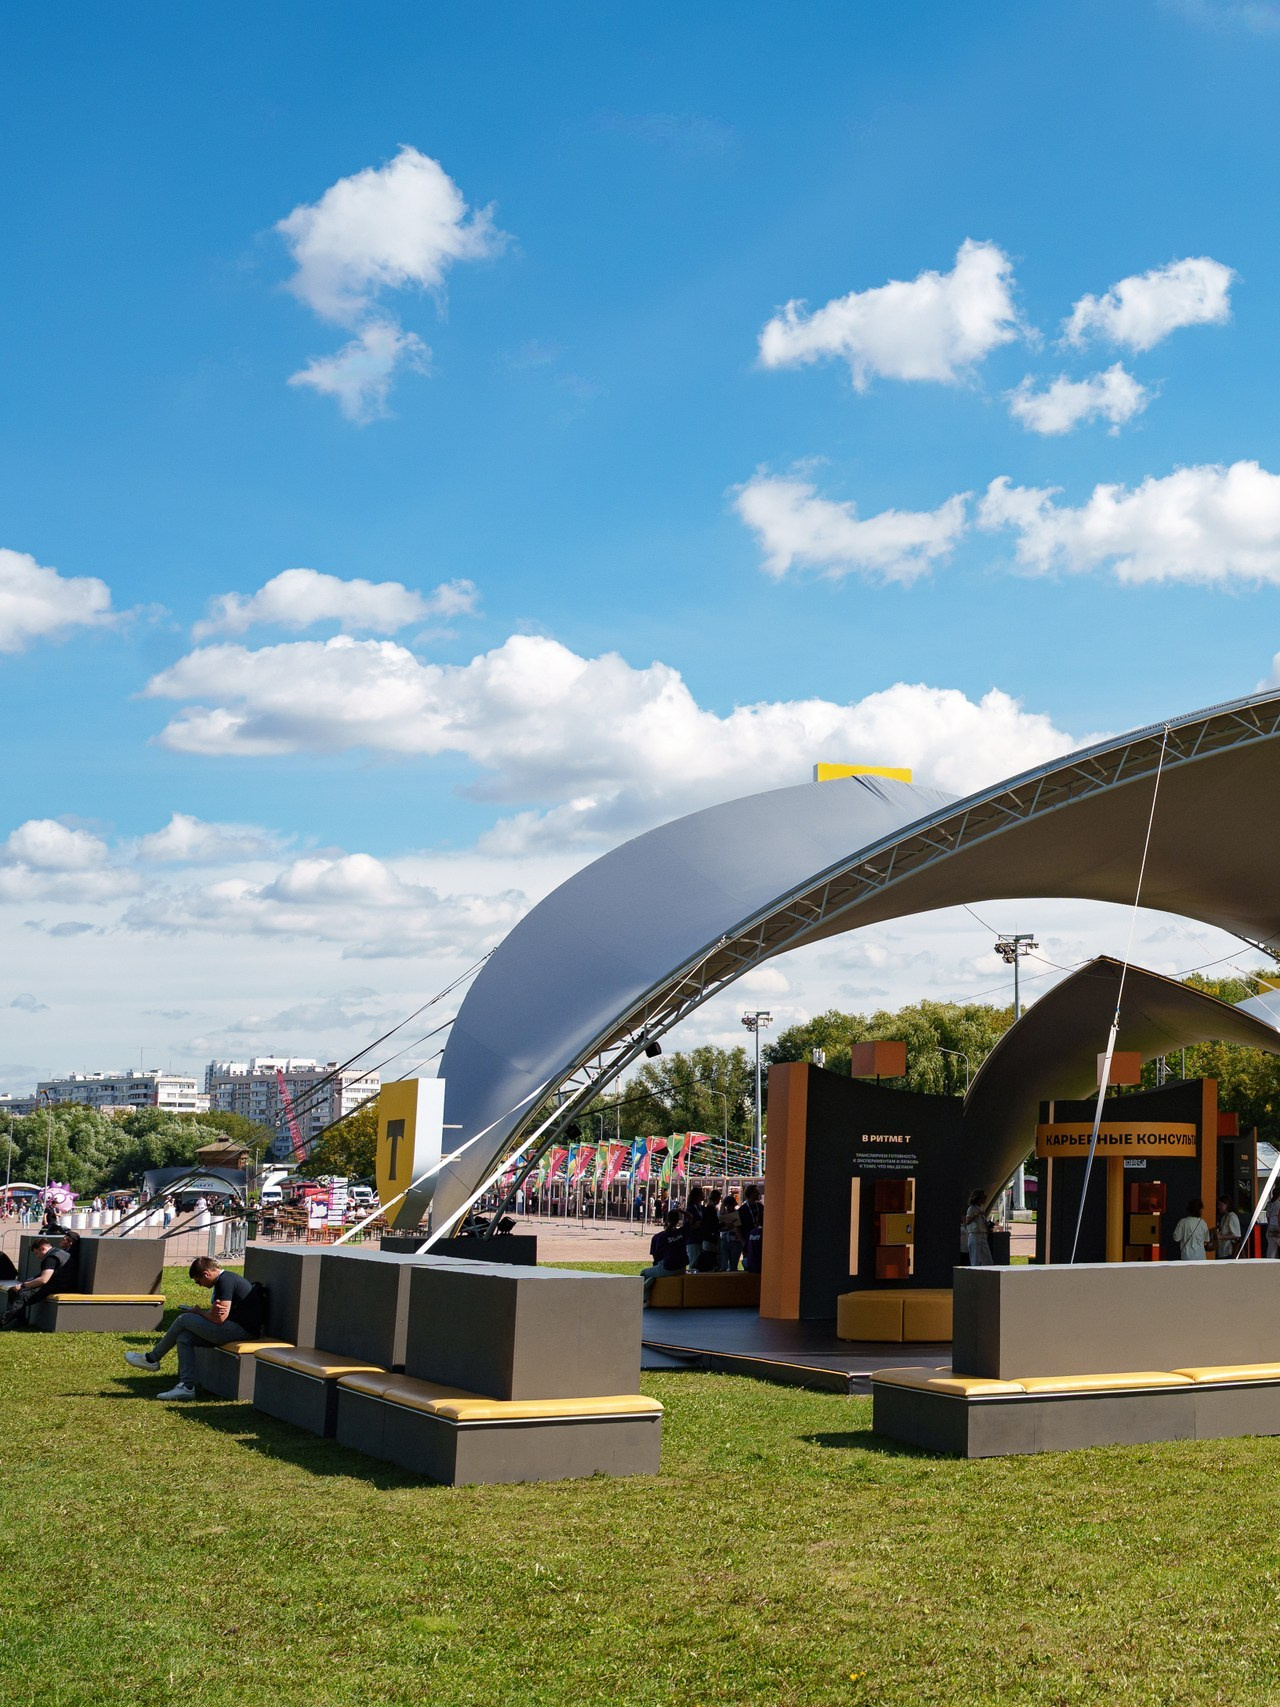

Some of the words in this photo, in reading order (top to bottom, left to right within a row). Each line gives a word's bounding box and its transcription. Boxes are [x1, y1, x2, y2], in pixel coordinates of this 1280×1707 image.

[870, 1134, 903, 1143] РИТМЕ
[1046, 1133, 1133, 1146] КАРЬЕРНЫЕ
[386, 1118, 406, 1181] T
